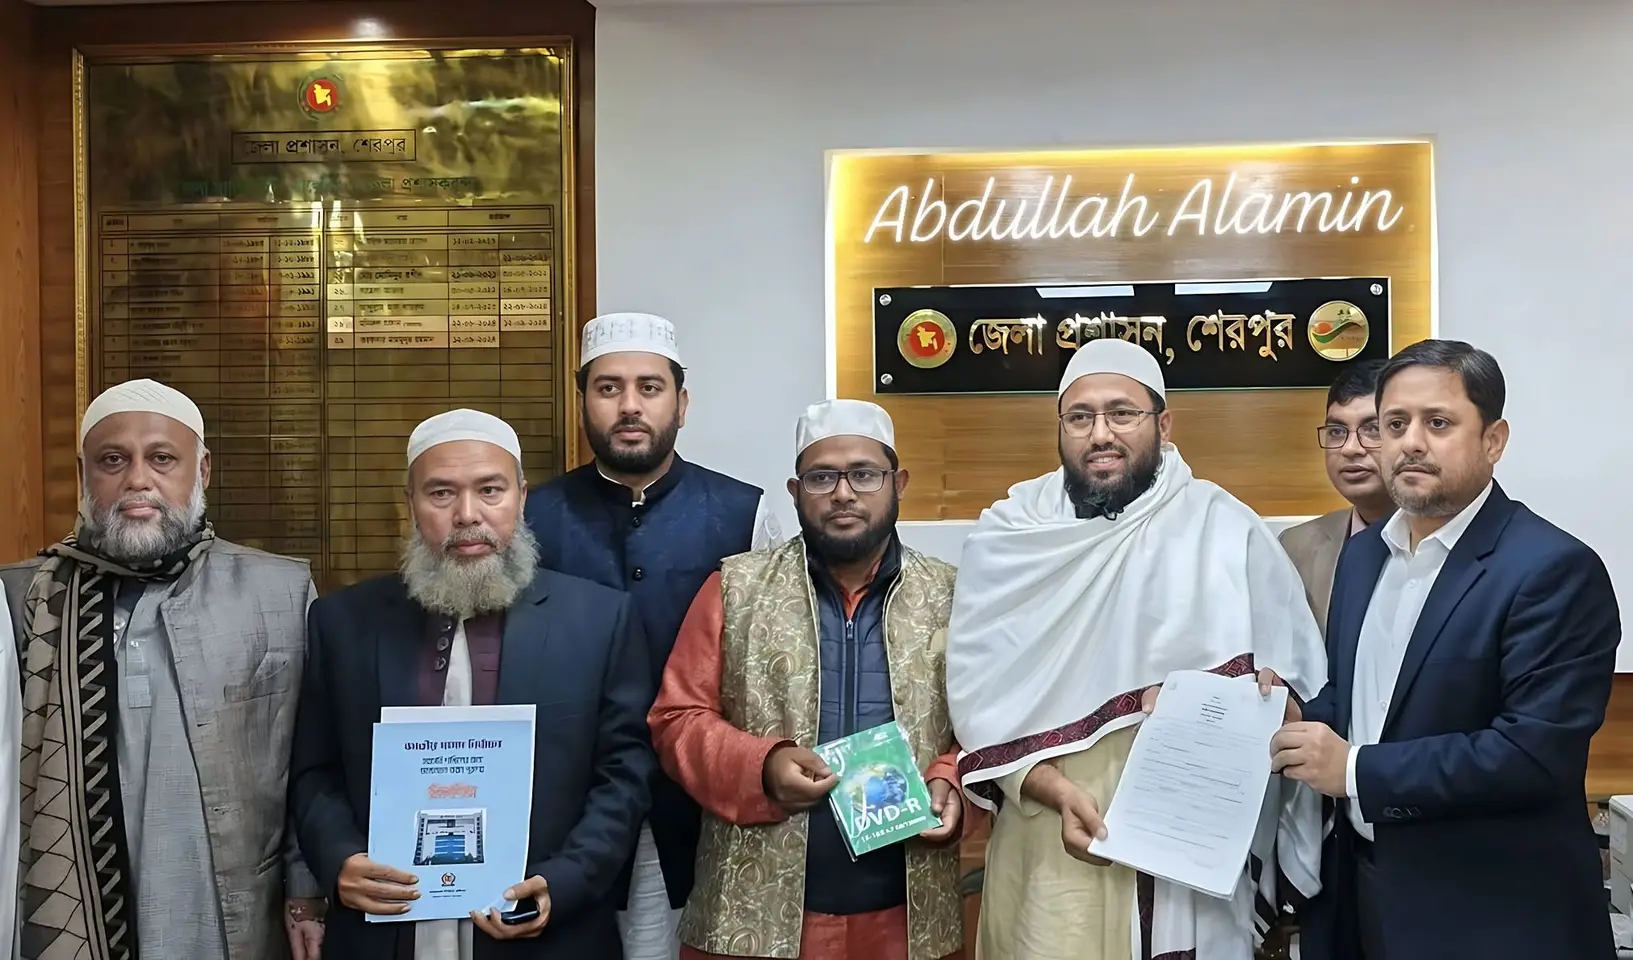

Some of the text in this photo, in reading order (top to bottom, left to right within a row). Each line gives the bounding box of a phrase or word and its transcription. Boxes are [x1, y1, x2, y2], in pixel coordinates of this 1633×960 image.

[353, 137, 406, 155] শেরপুর
[864, 173, 1404, 243] Abdullah Alamin
[969, 312, 1048, 356] জেলা
[1187, 308, 1297, 363] শেরপুর
[854, 797, 922, 831] DVD-R
